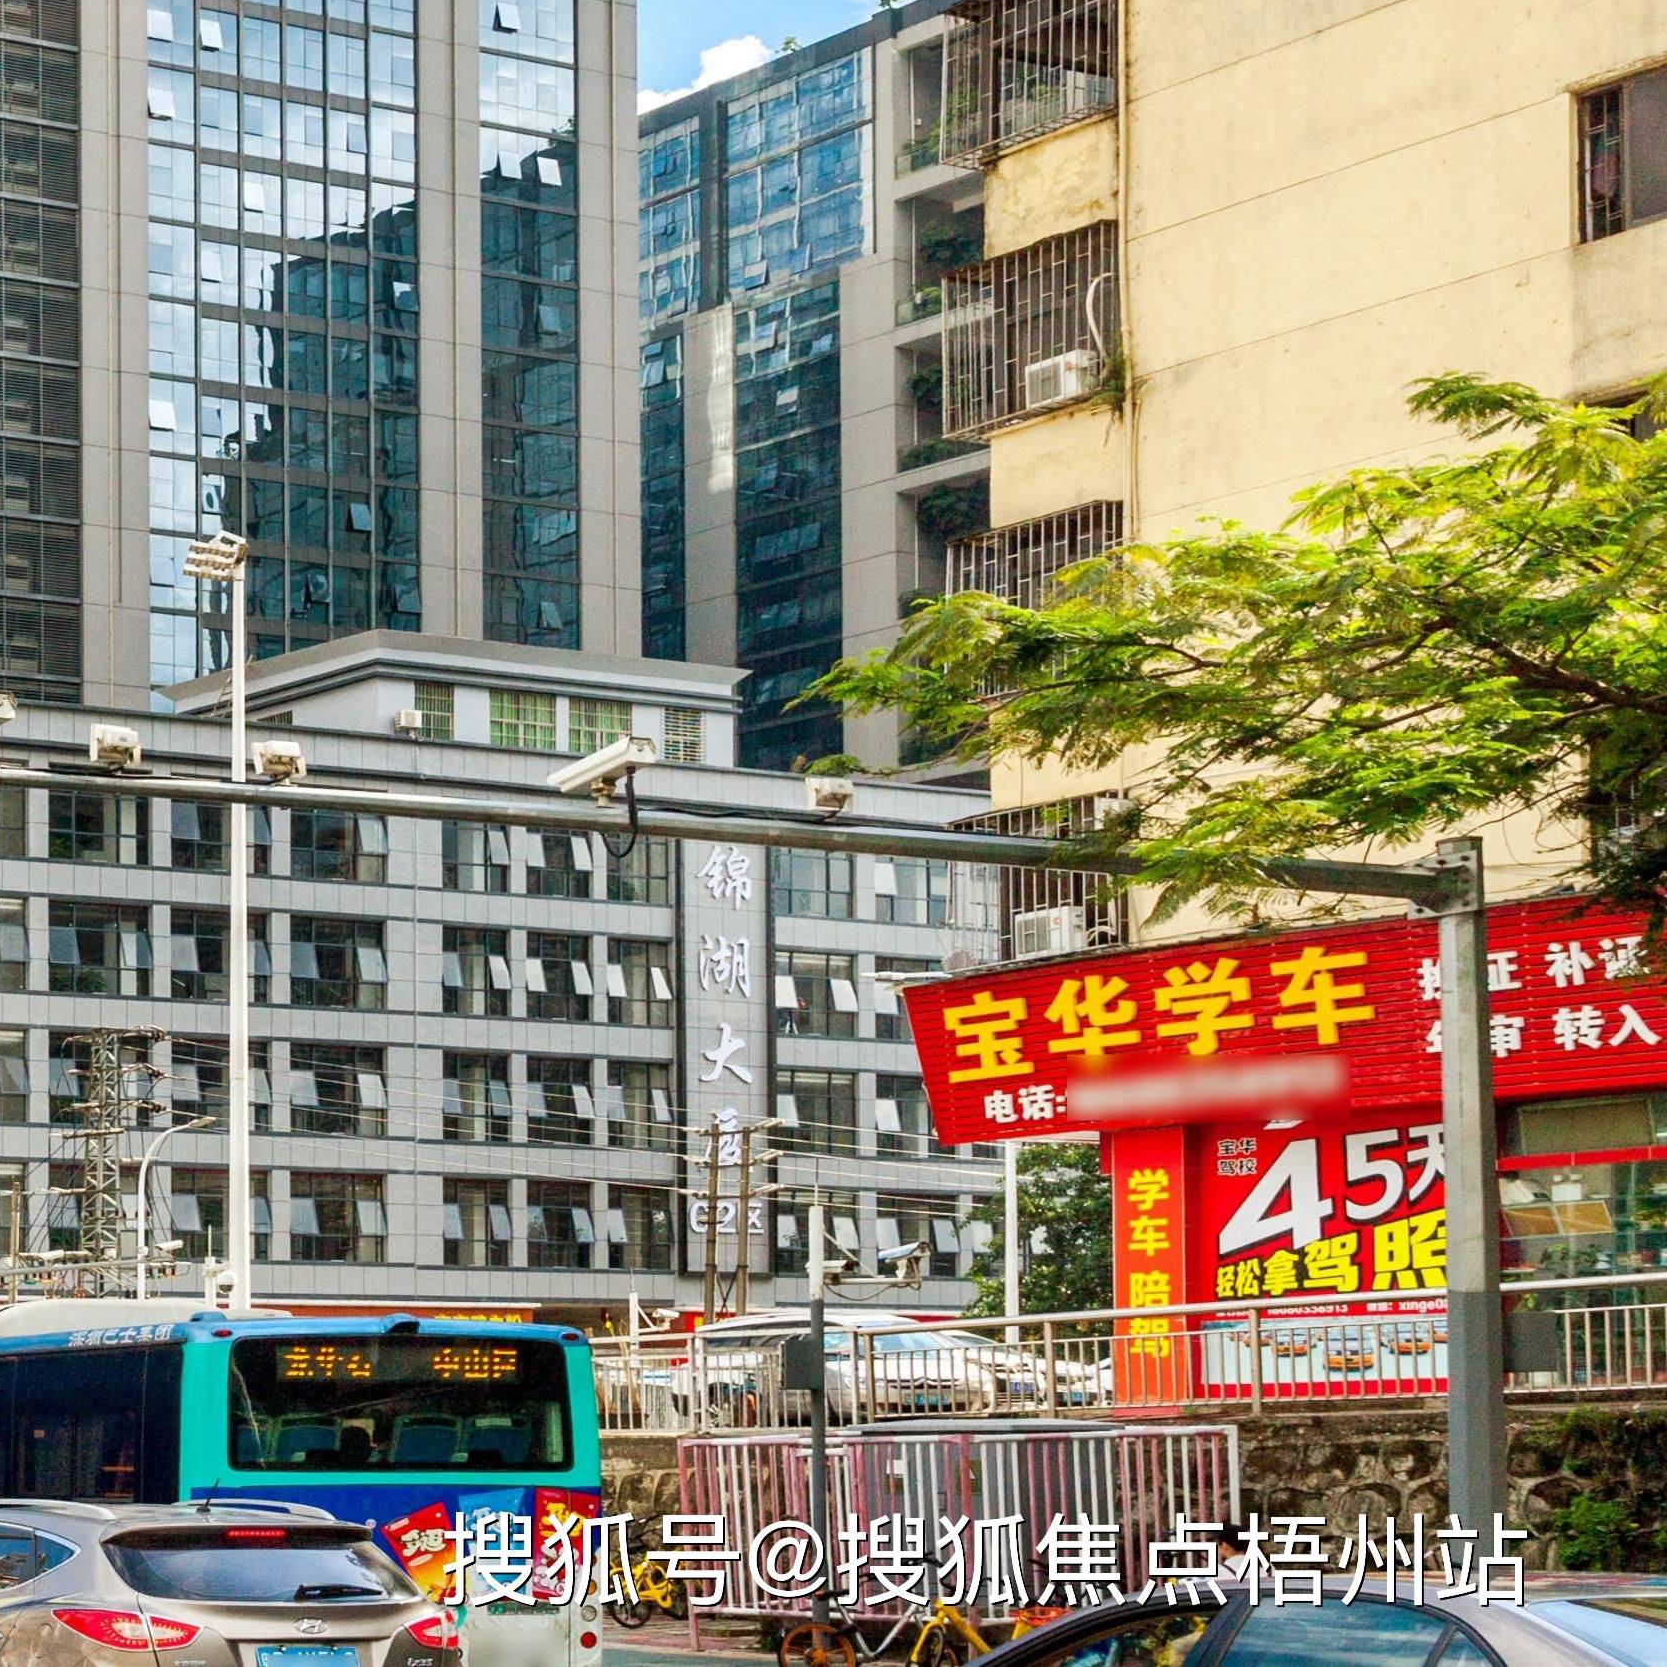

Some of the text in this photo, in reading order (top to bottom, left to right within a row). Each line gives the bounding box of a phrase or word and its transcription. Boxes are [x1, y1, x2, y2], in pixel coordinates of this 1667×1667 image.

[943, 946, 1376, 1083] 宝华学车
[1552, 1004, 1662, 1051] 转入
[1218, 1138, 1257, 1156] 宝华
[1218, 1158, 1257, 1176] 驾校
[1128, 1168, 1172, 1359] 学车 陪驾
[1215, 1209, 1447, 1299] 轻松拿驾照
[68, 1323, 174, 1348] 深圳巴士集团
